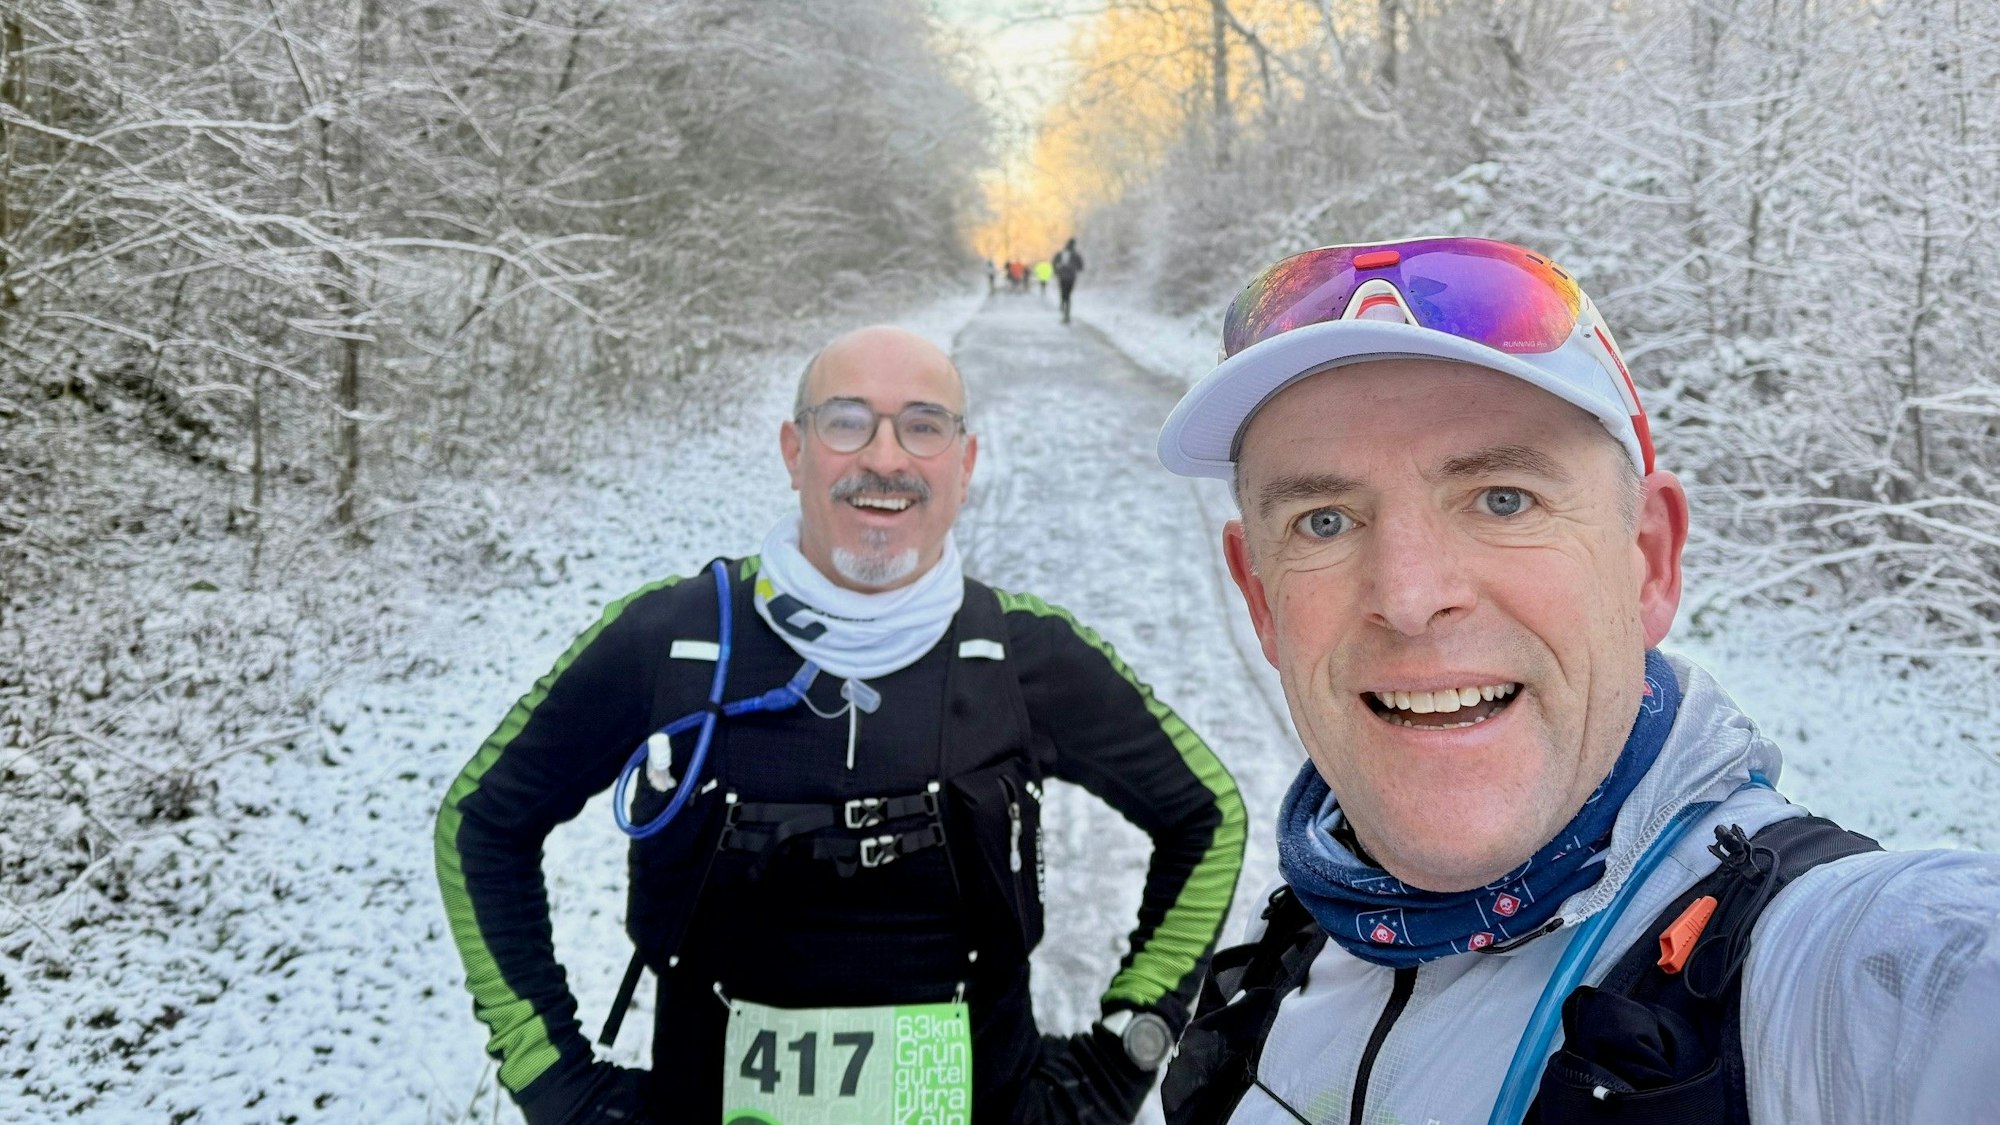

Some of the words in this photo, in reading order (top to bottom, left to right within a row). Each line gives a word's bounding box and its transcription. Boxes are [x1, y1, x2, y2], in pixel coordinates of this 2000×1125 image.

[896, 1014, 964, 1040] 63km
[740, 1029, 874, 1096] 417
[896, 1038, 966, 1067] Grün
